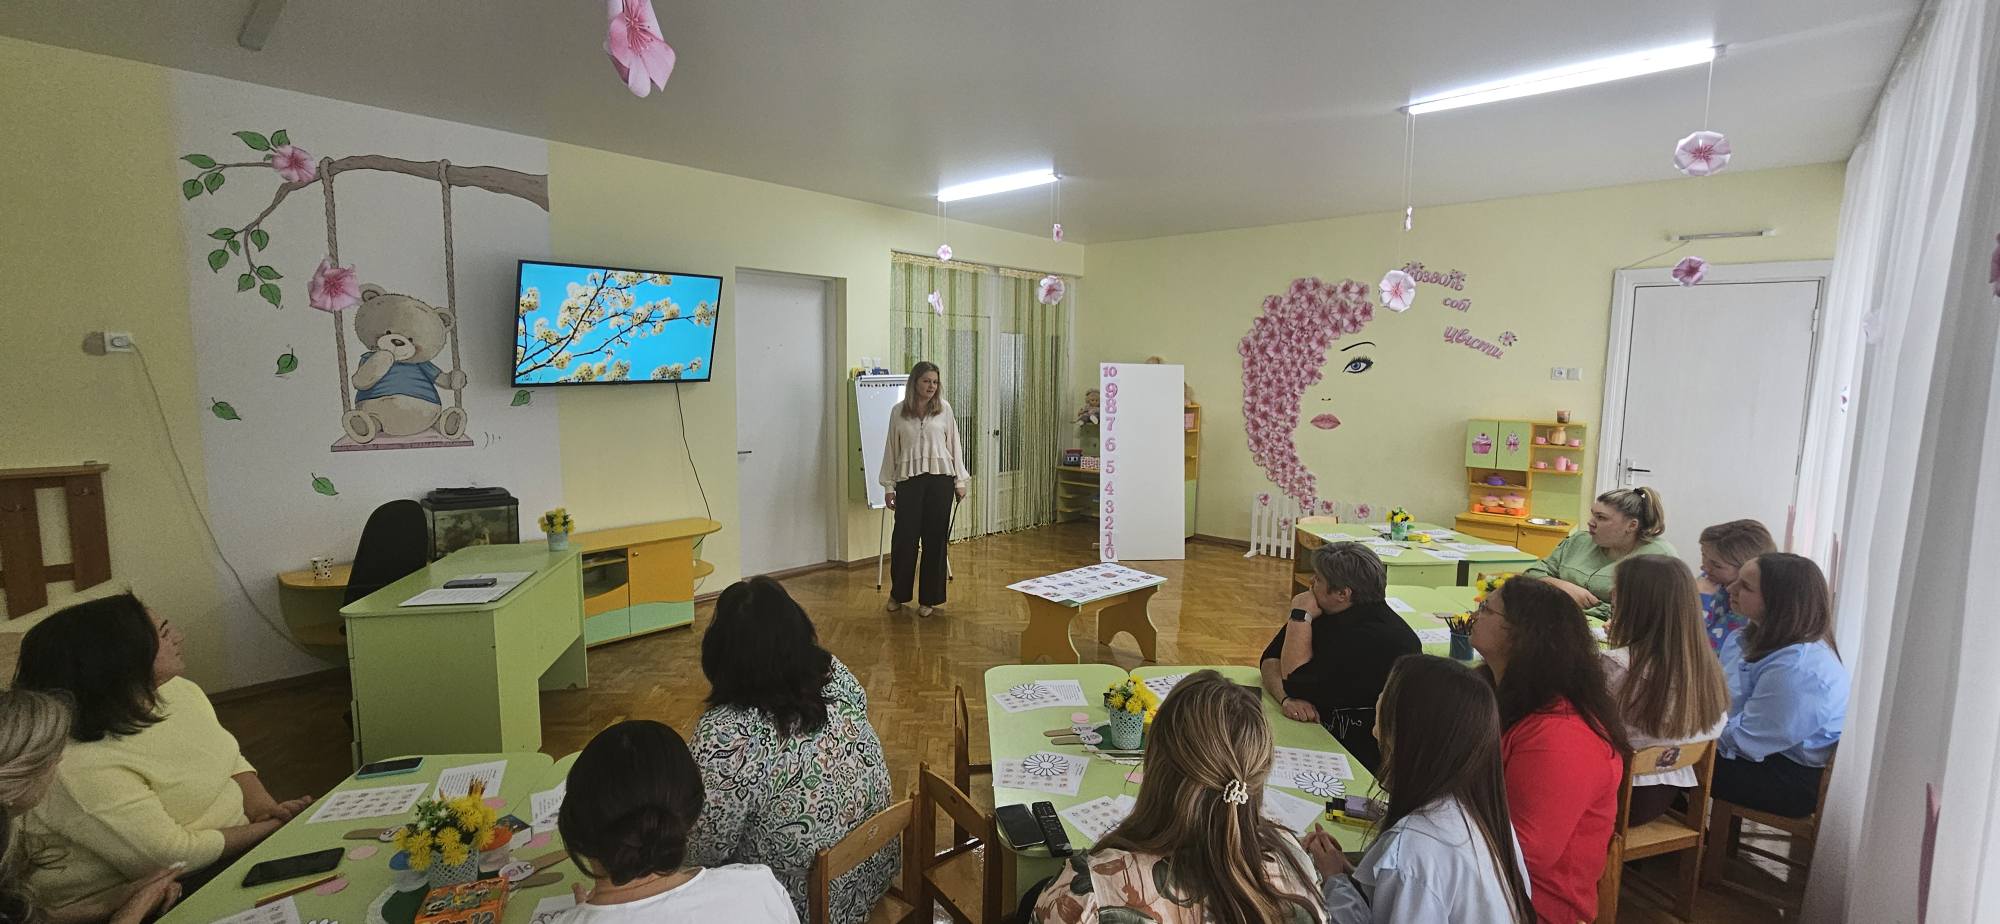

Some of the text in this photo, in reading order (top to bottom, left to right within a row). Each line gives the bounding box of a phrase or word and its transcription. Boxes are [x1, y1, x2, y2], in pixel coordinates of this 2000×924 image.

[1401, 266, 1464, 291] озволь
[1103, 366, 1117, 377] 10
[1105, 382, 1118, 399] 9
[1105, 399, 1117, 414] 8
[1105, 416, 1116, 431] 7
[1105, 437, 1116, 452] 6
[1105, 460, 1115, 474] 5
[1104, 481, 1114, 496] 4
[1105, 500, 1114, 514] 3
[1104, 515, 1114, 530] 2
[1104, 531, 1114, 547] 1
[1104, 546, 1114, 560] 0
